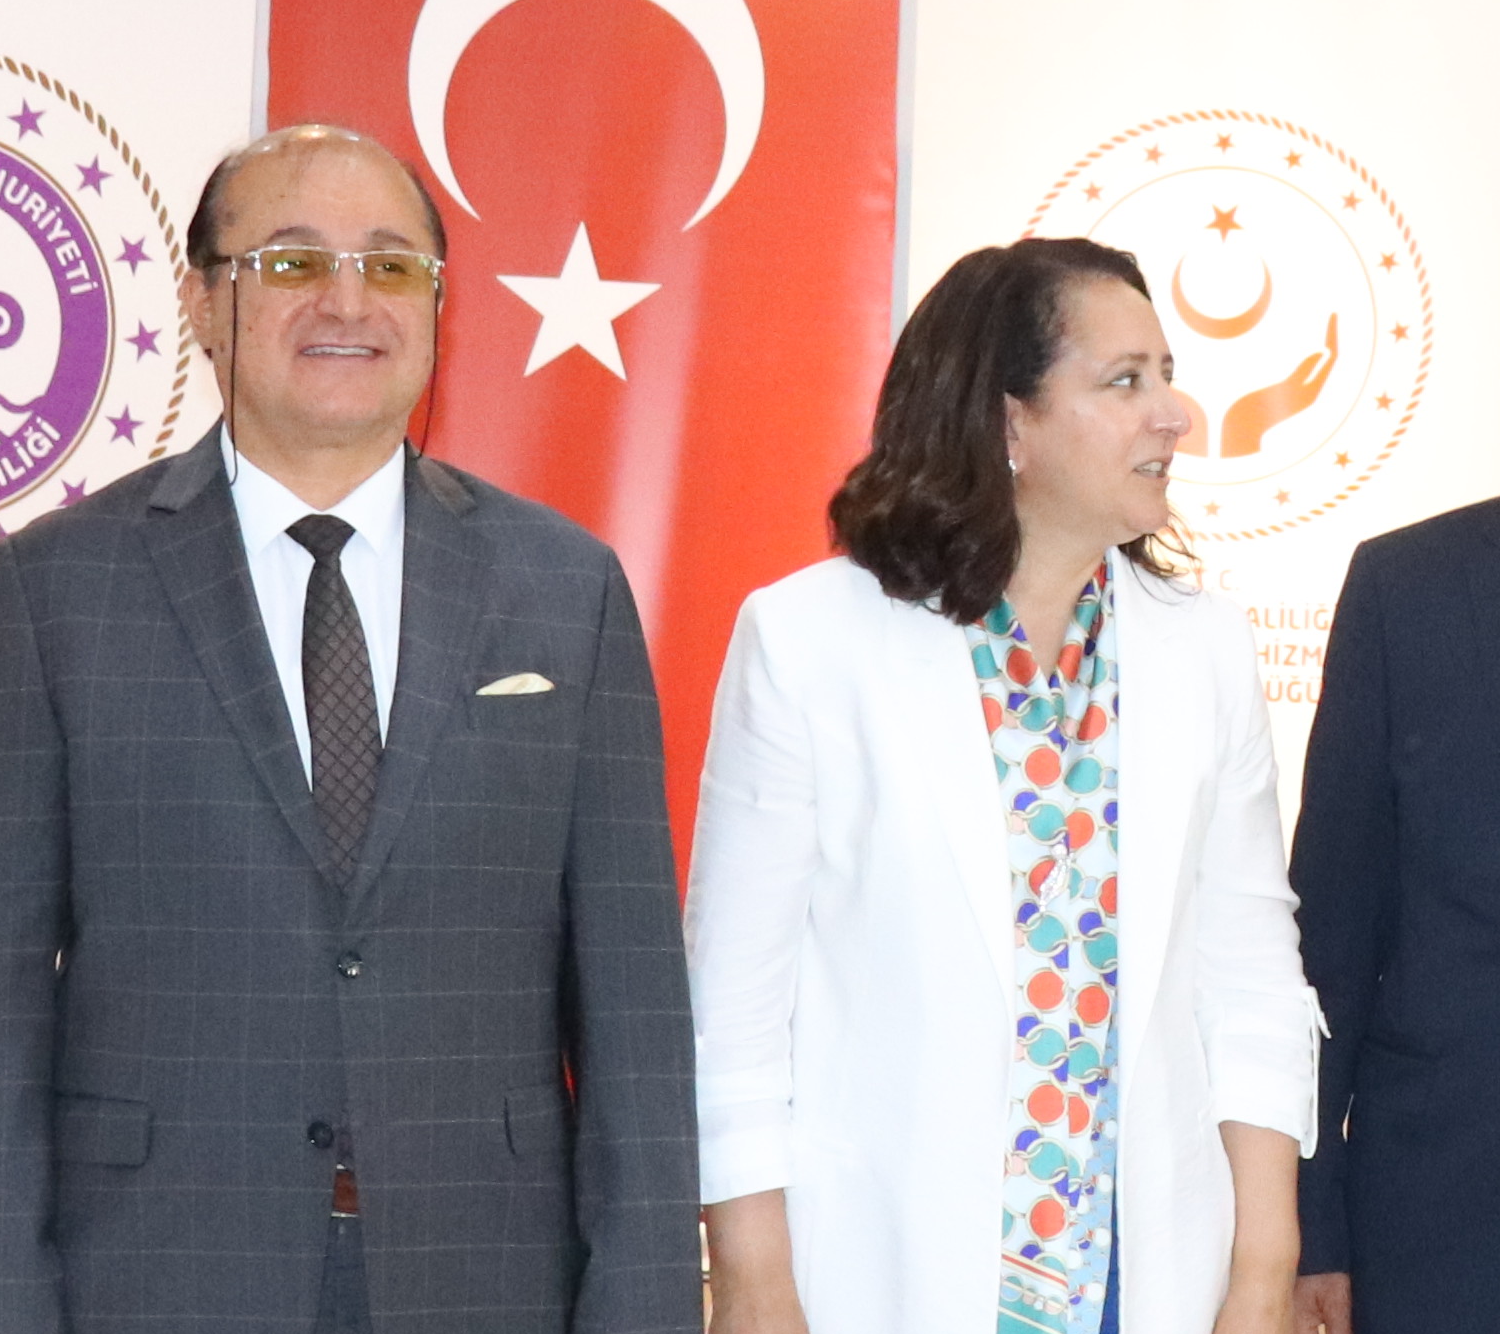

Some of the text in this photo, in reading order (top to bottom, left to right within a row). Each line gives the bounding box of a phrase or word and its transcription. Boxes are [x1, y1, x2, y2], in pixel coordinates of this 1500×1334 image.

[1246, 602, 1331, 631] ALİLİĞ
[1257, 638, 1323, 667] HİZM
[1266, 675, 1322, 704] ÜĞÜ
